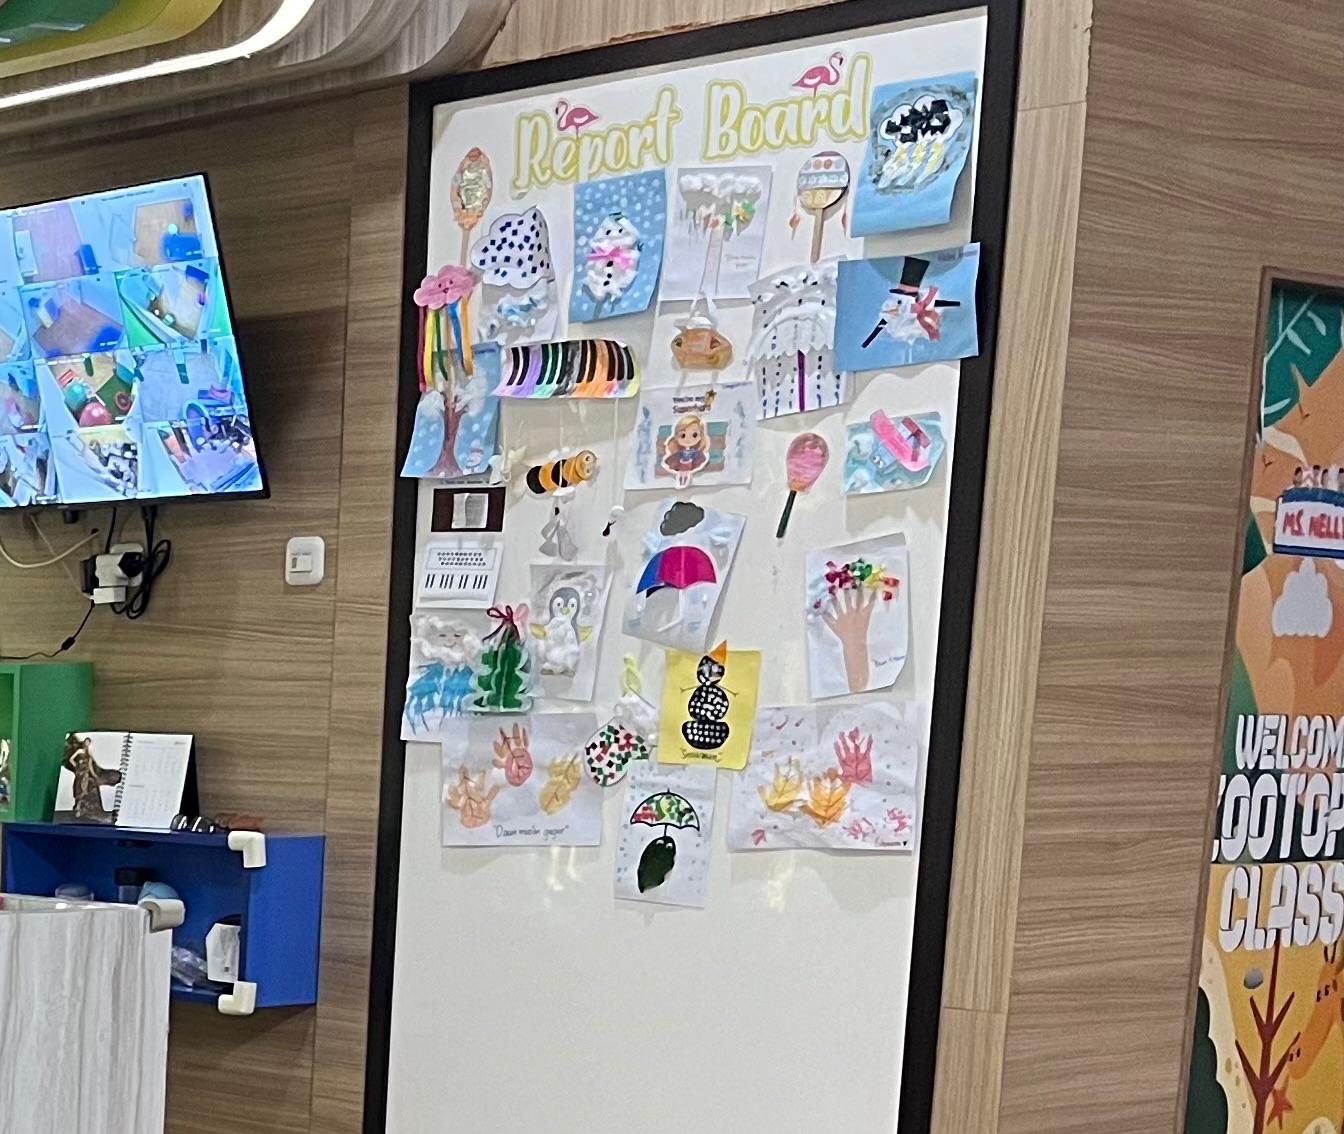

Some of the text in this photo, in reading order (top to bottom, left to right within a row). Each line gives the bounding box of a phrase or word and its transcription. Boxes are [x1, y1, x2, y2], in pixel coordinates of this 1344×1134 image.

[511, 52, 873, 191] Report Board
[1236, 714, 1344, 769] WELCOM
[1212, 773, 1344, 861] OOTOP
[1219, 863, 1344, 952] CLASS
